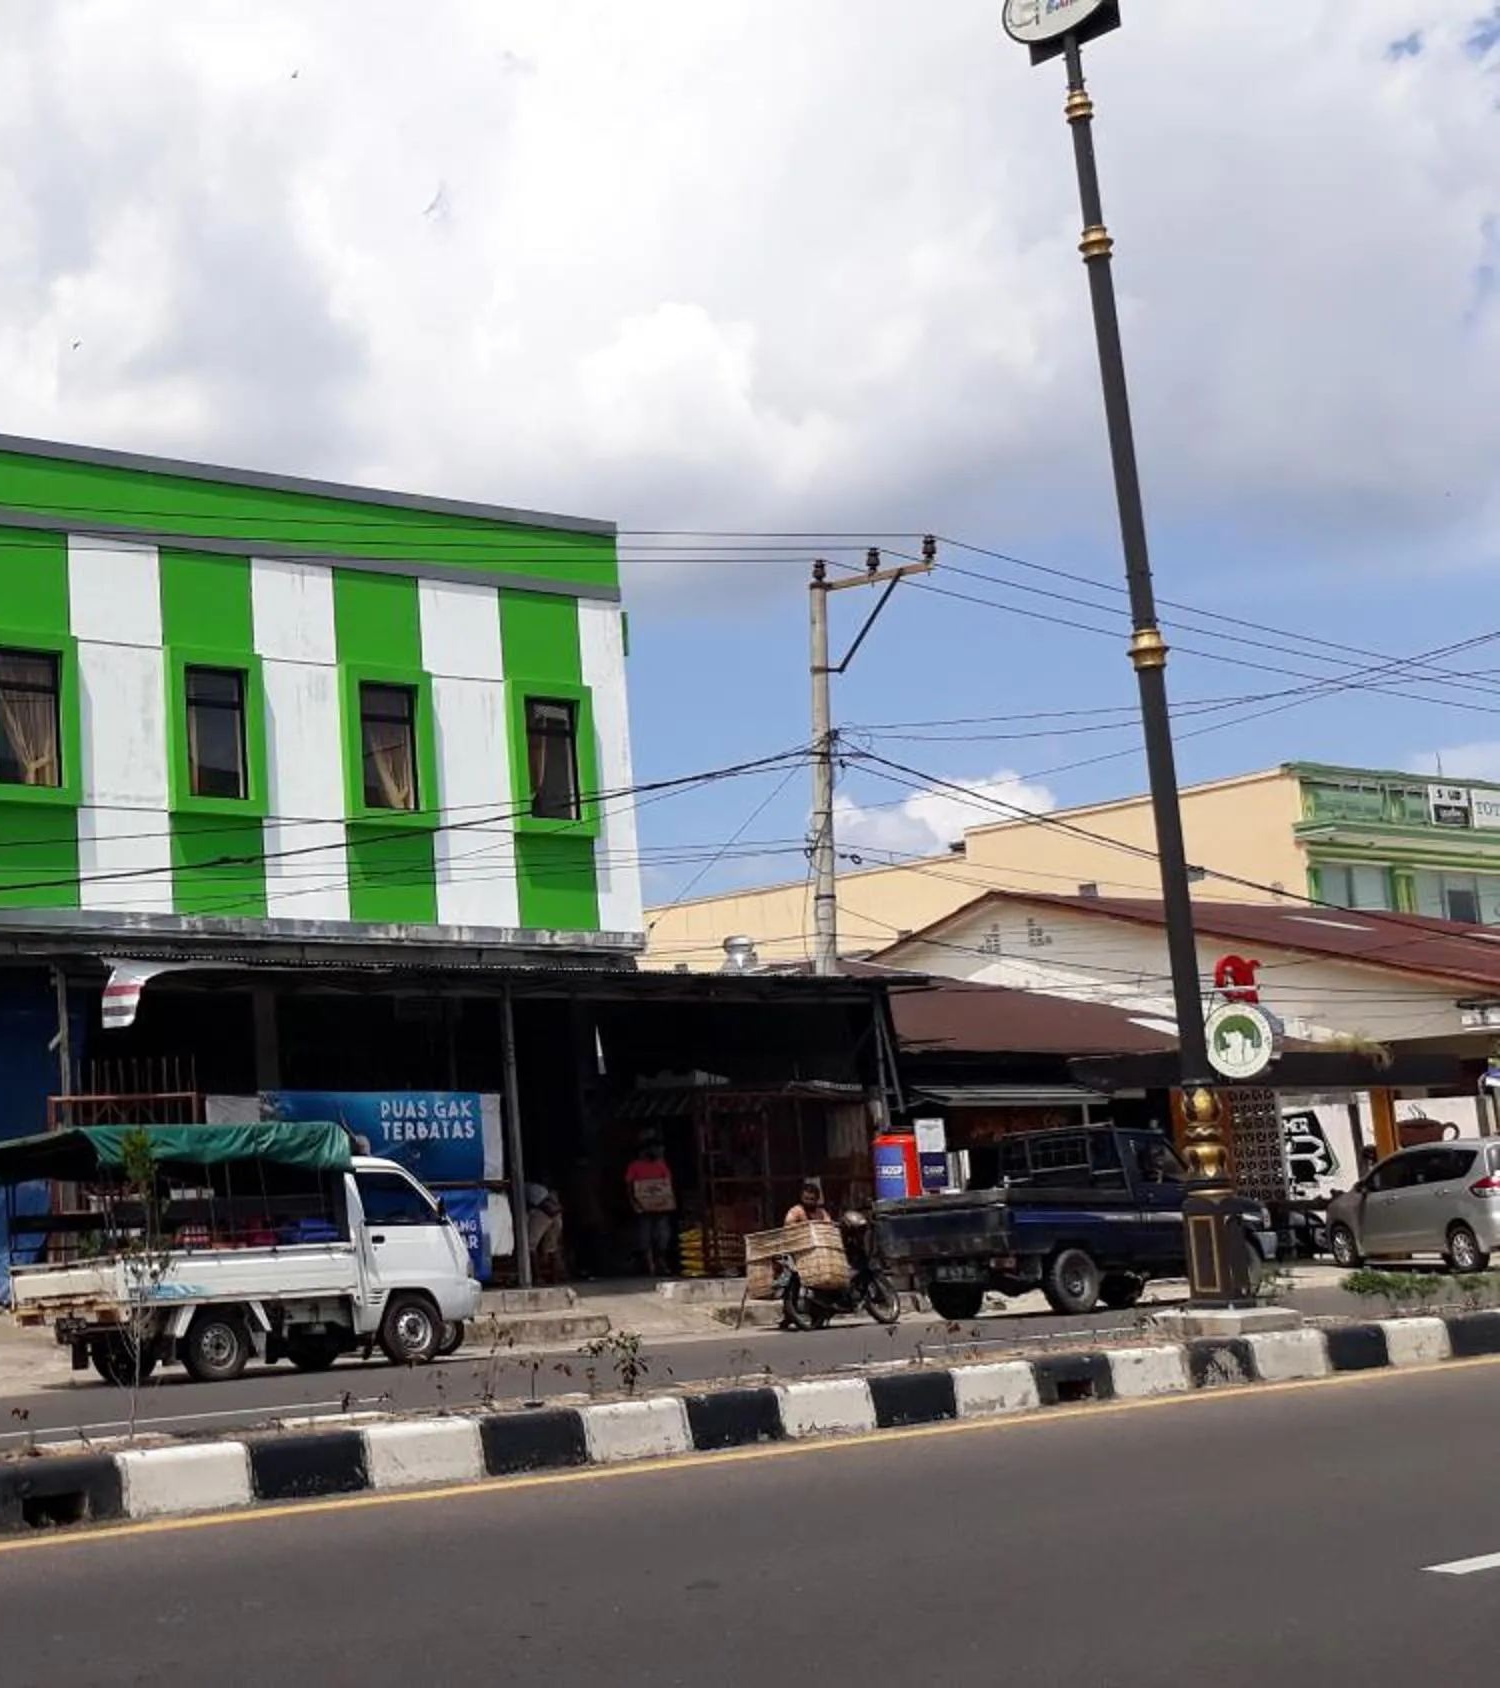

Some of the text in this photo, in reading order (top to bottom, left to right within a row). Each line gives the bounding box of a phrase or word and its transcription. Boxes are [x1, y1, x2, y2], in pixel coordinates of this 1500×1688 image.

[380, 1099, 473, 1119] PUAS GAK
[381, 1120, 475, 1141] TERBATAS
